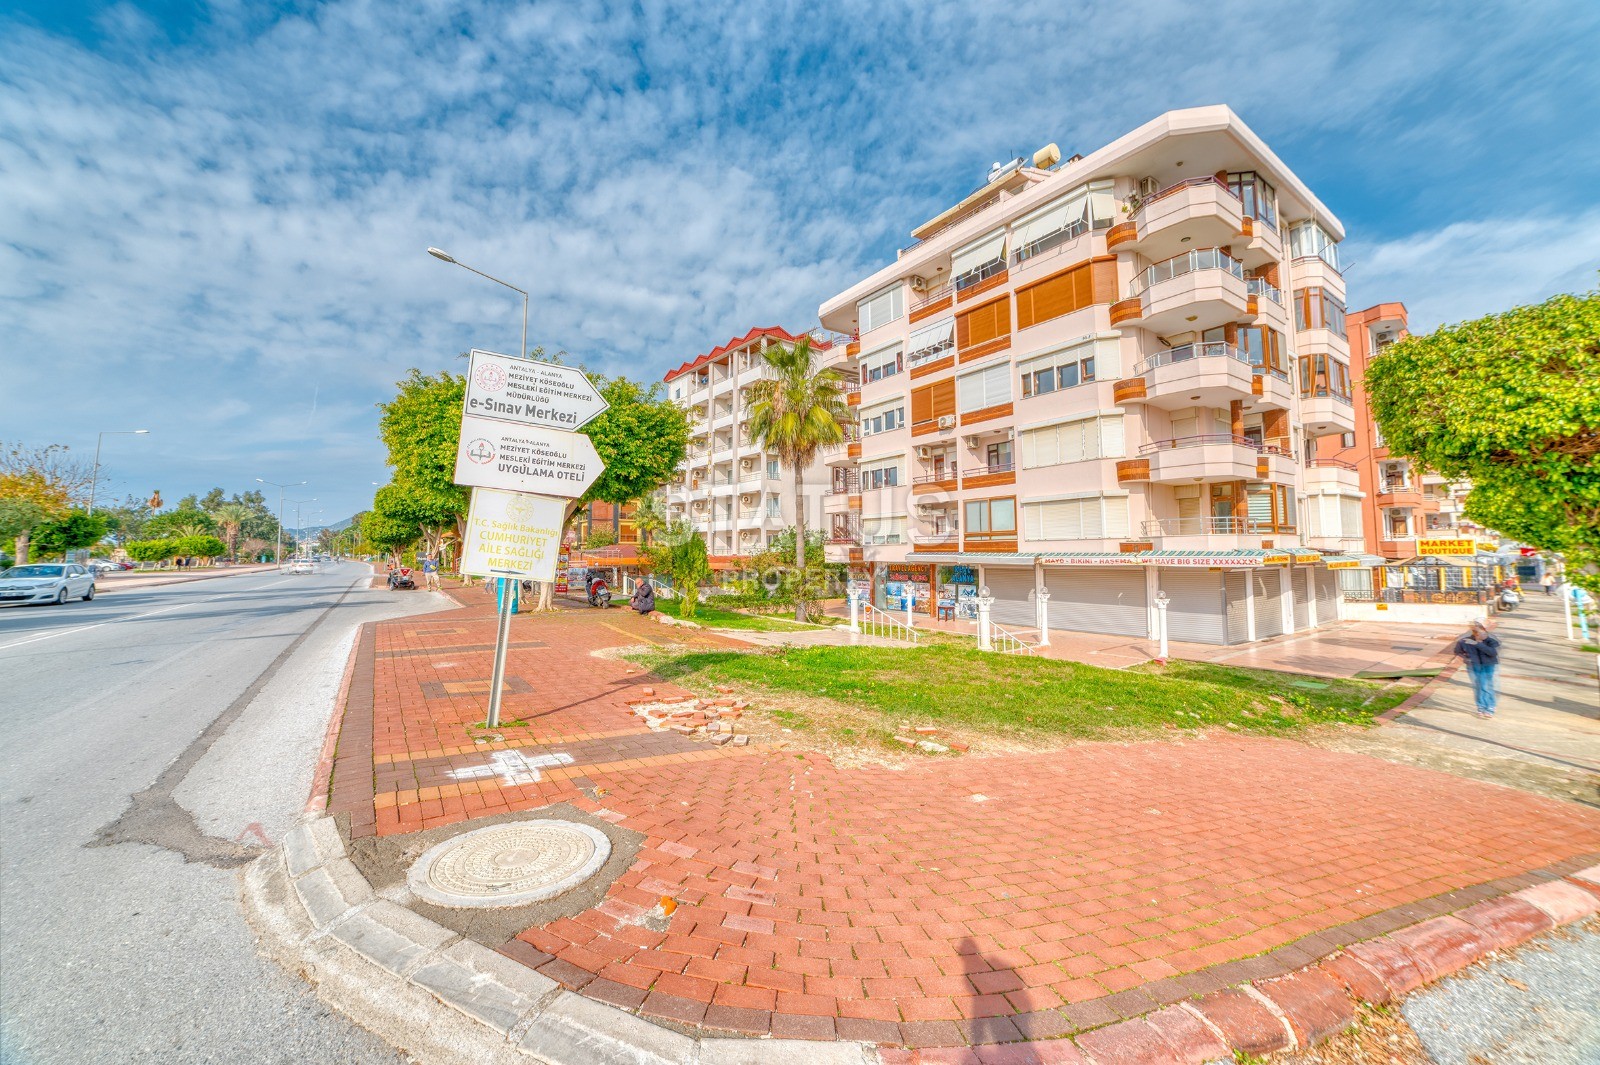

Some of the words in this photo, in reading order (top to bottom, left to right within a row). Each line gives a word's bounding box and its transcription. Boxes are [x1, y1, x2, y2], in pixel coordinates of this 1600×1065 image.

[509, 364, 536, 374] ANTALYA
[540, 370, 563, 379] ALANYA
[508, 373, 538, 383] MEZİYET
[540, 378, 574, 390] KÖSEOĞLU
[506, 391, 550, 404] MÜDÜRLÜĞÜ
[507, 382, 538, 392] MESLEKİ
[538, 387, 562, 397] EĞİTİM
[563, 392, 592, 402] MERKEZİ
[470, 397, 522, 416] e-Sınav
[525, 404, 578, 424] Merkezi
[500, 444, 530, 454] MEZİYET
[532, 448, 567, 459] KÖSEOĞLU
[500, 454, 531, 464] MESLEKİ
[532, 457, 555, 467] EĞİTİM
[556, 461, 586, 471] MERKEZİ
[557, 471, 585, 482] OTELİ
[474, 518, 489, 528] T.C.
[492, 520, 518, 532] Sağlık
[520, 524, 558, 538] Bakanlığı
[479, 530, 548, 547] CUMHURİYET
[478, 544, 504, 555] AİLE
[504, 546, 545, 560] SAĞLIĞI
[487, 556, 534, 571] MERKEZİ
